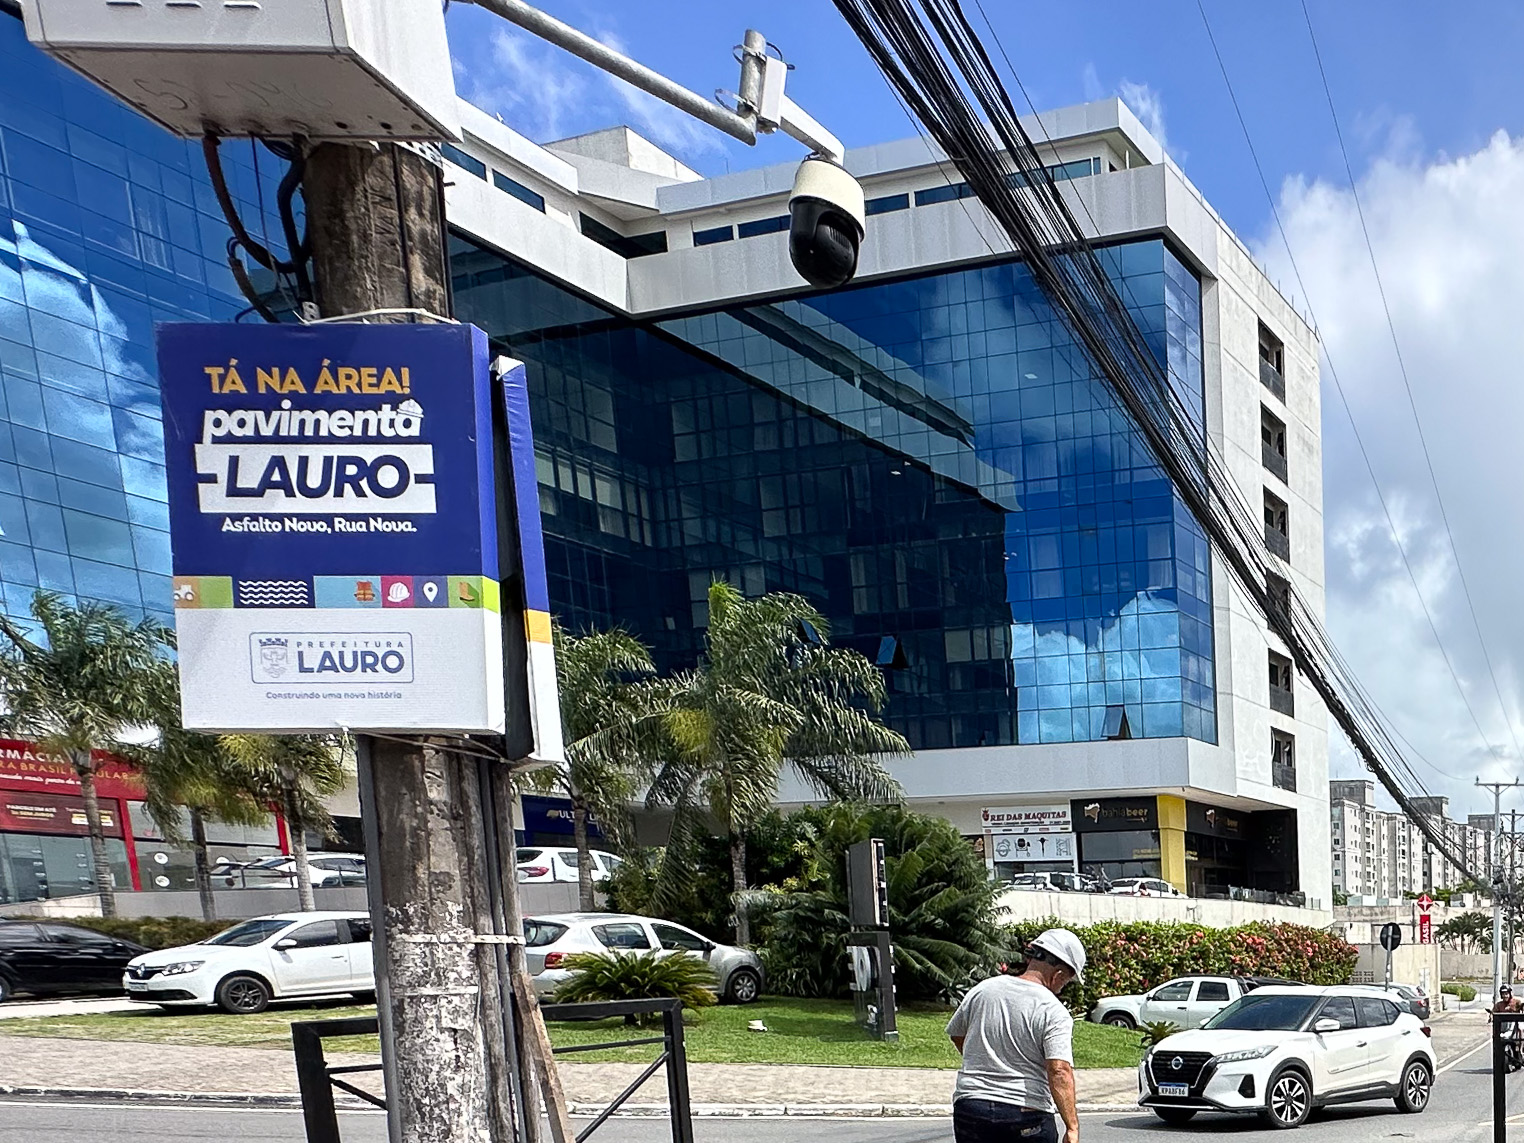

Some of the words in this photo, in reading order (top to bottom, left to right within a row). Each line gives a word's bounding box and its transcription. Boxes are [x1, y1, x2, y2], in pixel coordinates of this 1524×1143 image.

[204, 358, 248, 394] TÁ
[256, 366, 307, 394] NA
[313, 358, 411, 394] ÁREA!
[225, 454, 411, 499] LAURO
[221, 516, 282, 533] Asfalto
[284, 517, 331, 534] Novo,
[334, 517, 367, 533] Rua
[369, 517, 418, 533] Nova.
[297, 649, 405, 674] LAURO
[265, 691, 320, 700] Construindo
[367, 690, 402, 699] história
[20, 762, 67, 775] BRASIL
[990, 814, 1005, 822] REI
[1006, 813, 1022, 821] DAS
[1024, 811, 1067, 821] MAQUITAS
